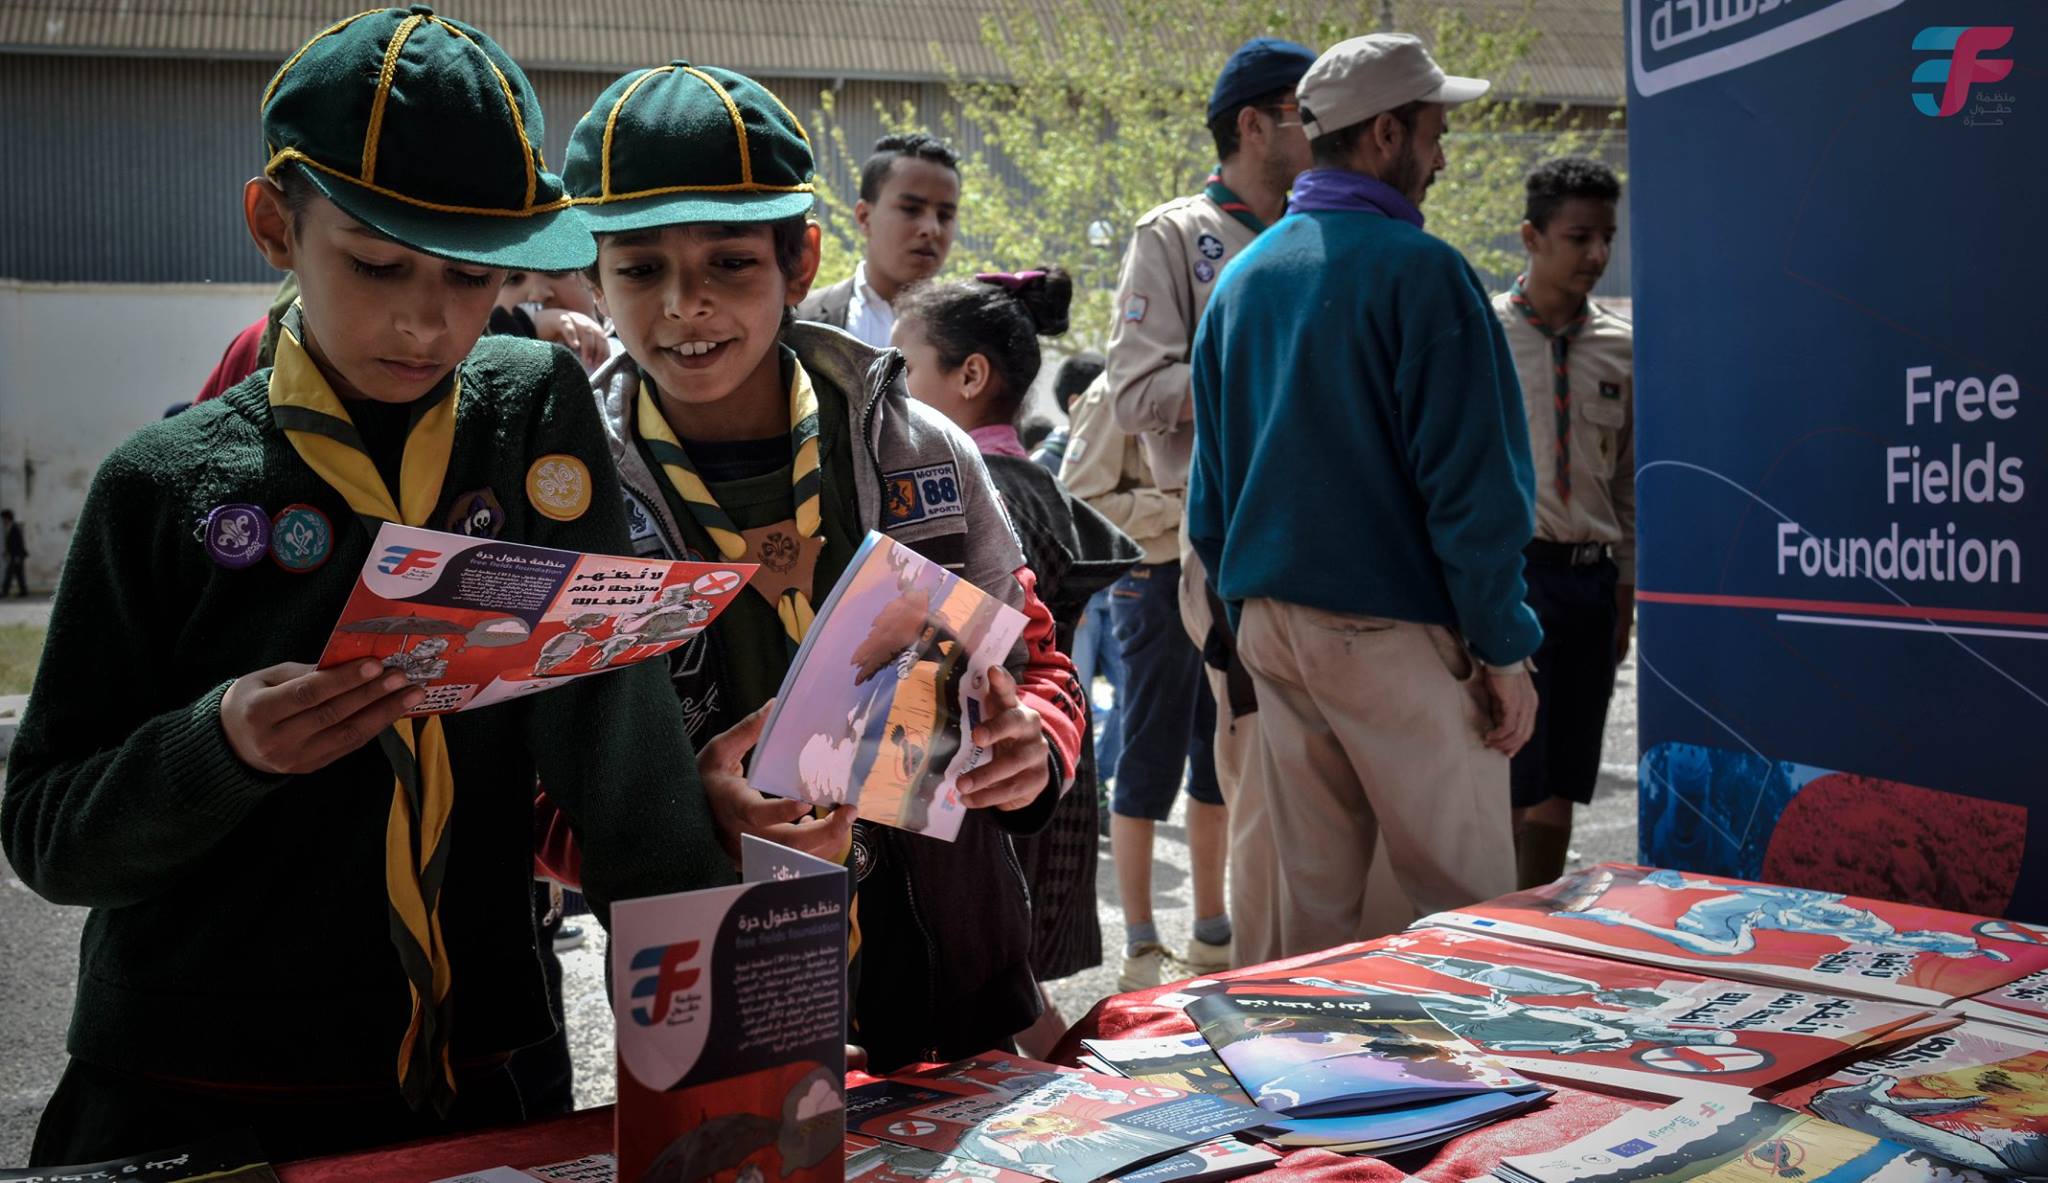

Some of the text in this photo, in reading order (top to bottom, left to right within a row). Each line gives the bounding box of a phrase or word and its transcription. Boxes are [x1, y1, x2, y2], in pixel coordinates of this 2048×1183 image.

[1906, 365, 2019, 425] Free
[916, 467, 953, 479] MOTOR
[1887, 442, 2025, 504] Fields
[922, 477, 957, 505] 88
[928, 505, 961, 515] SPORTS
[476, 551, 566, 568] منظمة حقول حرة
[1777, 522, 2021, 583] Foundation
[738, 901, 840, 931] منظمة حقول حرة
